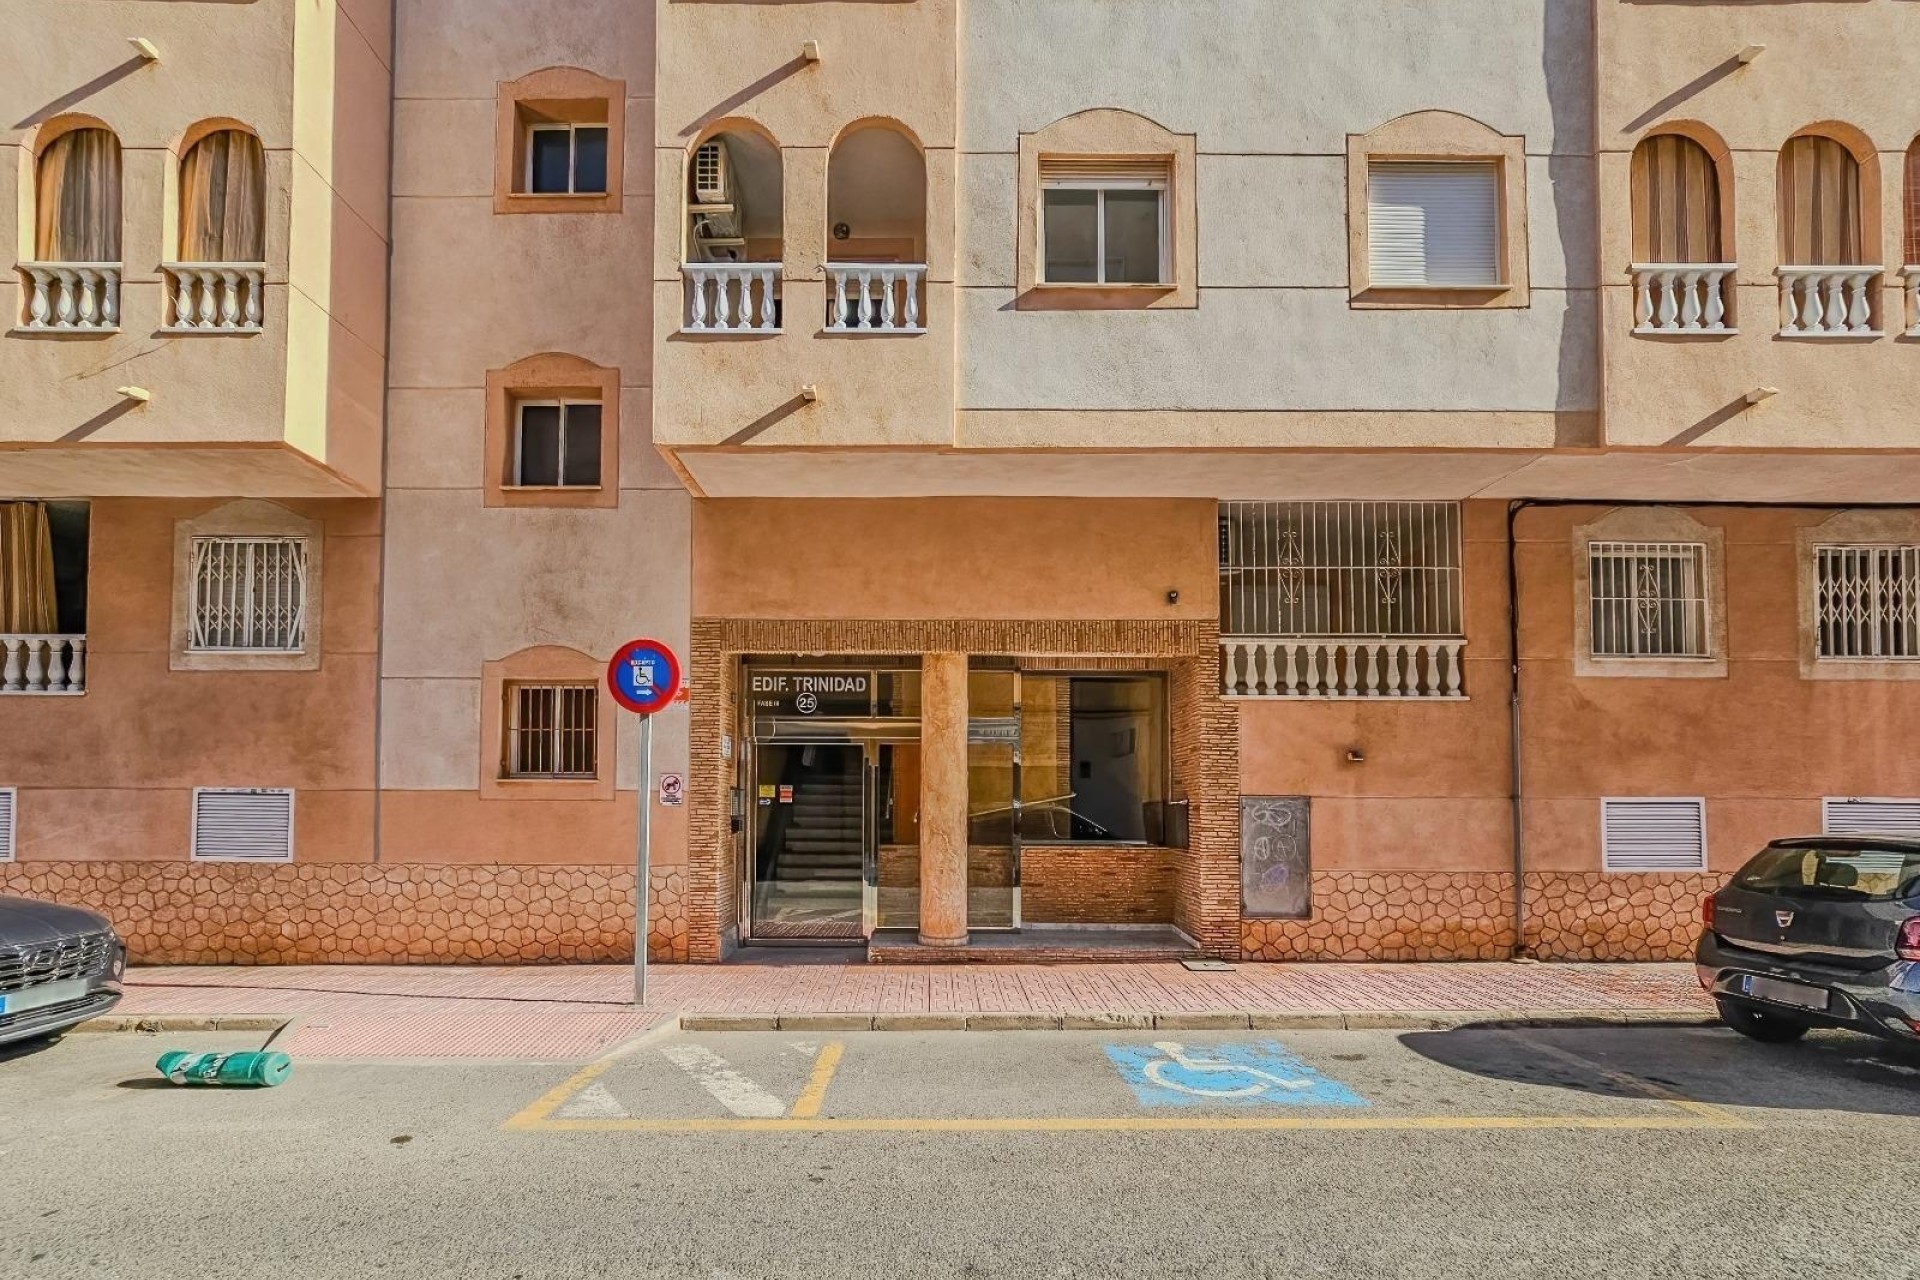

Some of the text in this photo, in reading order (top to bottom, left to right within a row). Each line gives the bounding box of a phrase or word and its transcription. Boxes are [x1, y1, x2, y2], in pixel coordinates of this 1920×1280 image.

[752, 676, 866, 692] EDIF. TRINIDAD
[799, 697, 815, 708] 25
